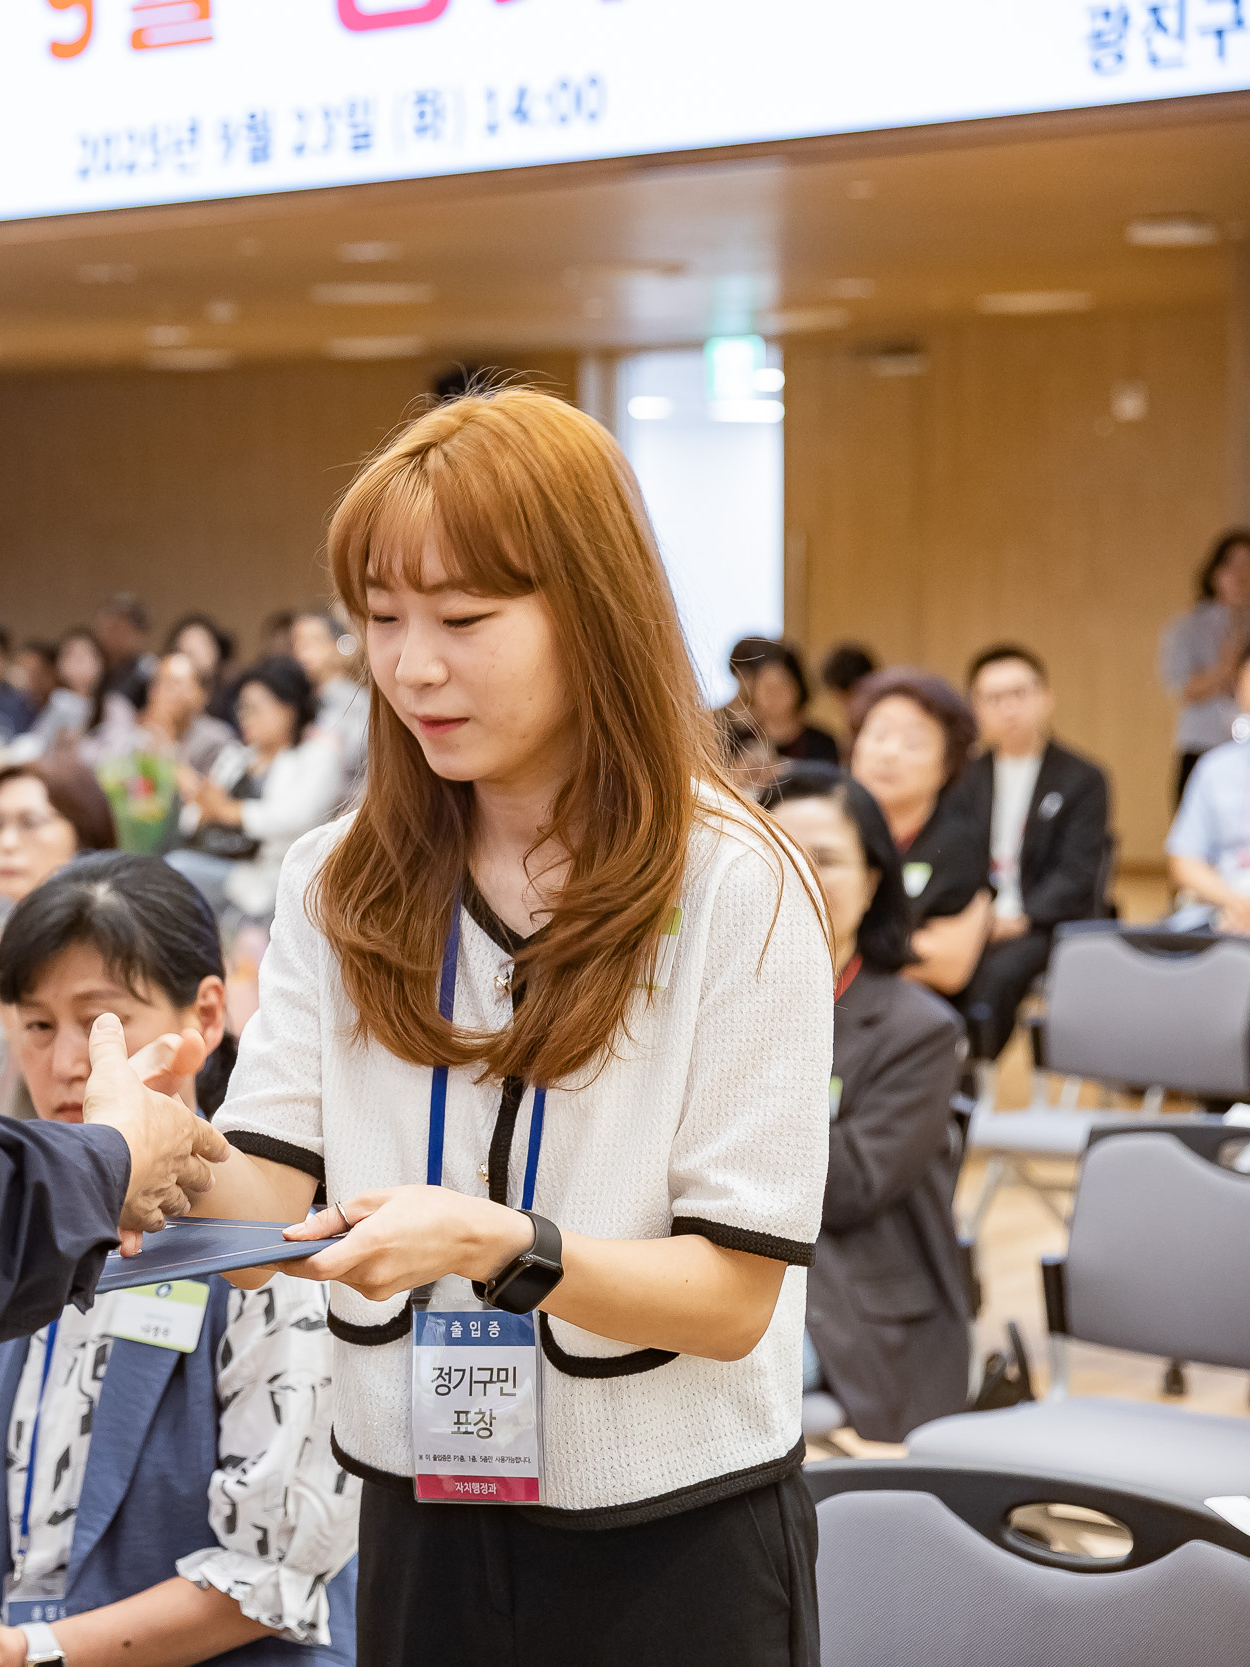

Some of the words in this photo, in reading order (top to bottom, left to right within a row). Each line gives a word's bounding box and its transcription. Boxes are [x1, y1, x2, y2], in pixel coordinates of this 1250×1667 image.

[482, 74, 607, 136] 14:00
[431, 1366, 517, 1397] 정기구민
[451, 1408, 497, 1440] 표창
[454, 1481, 497, 1495] 자치행정과
